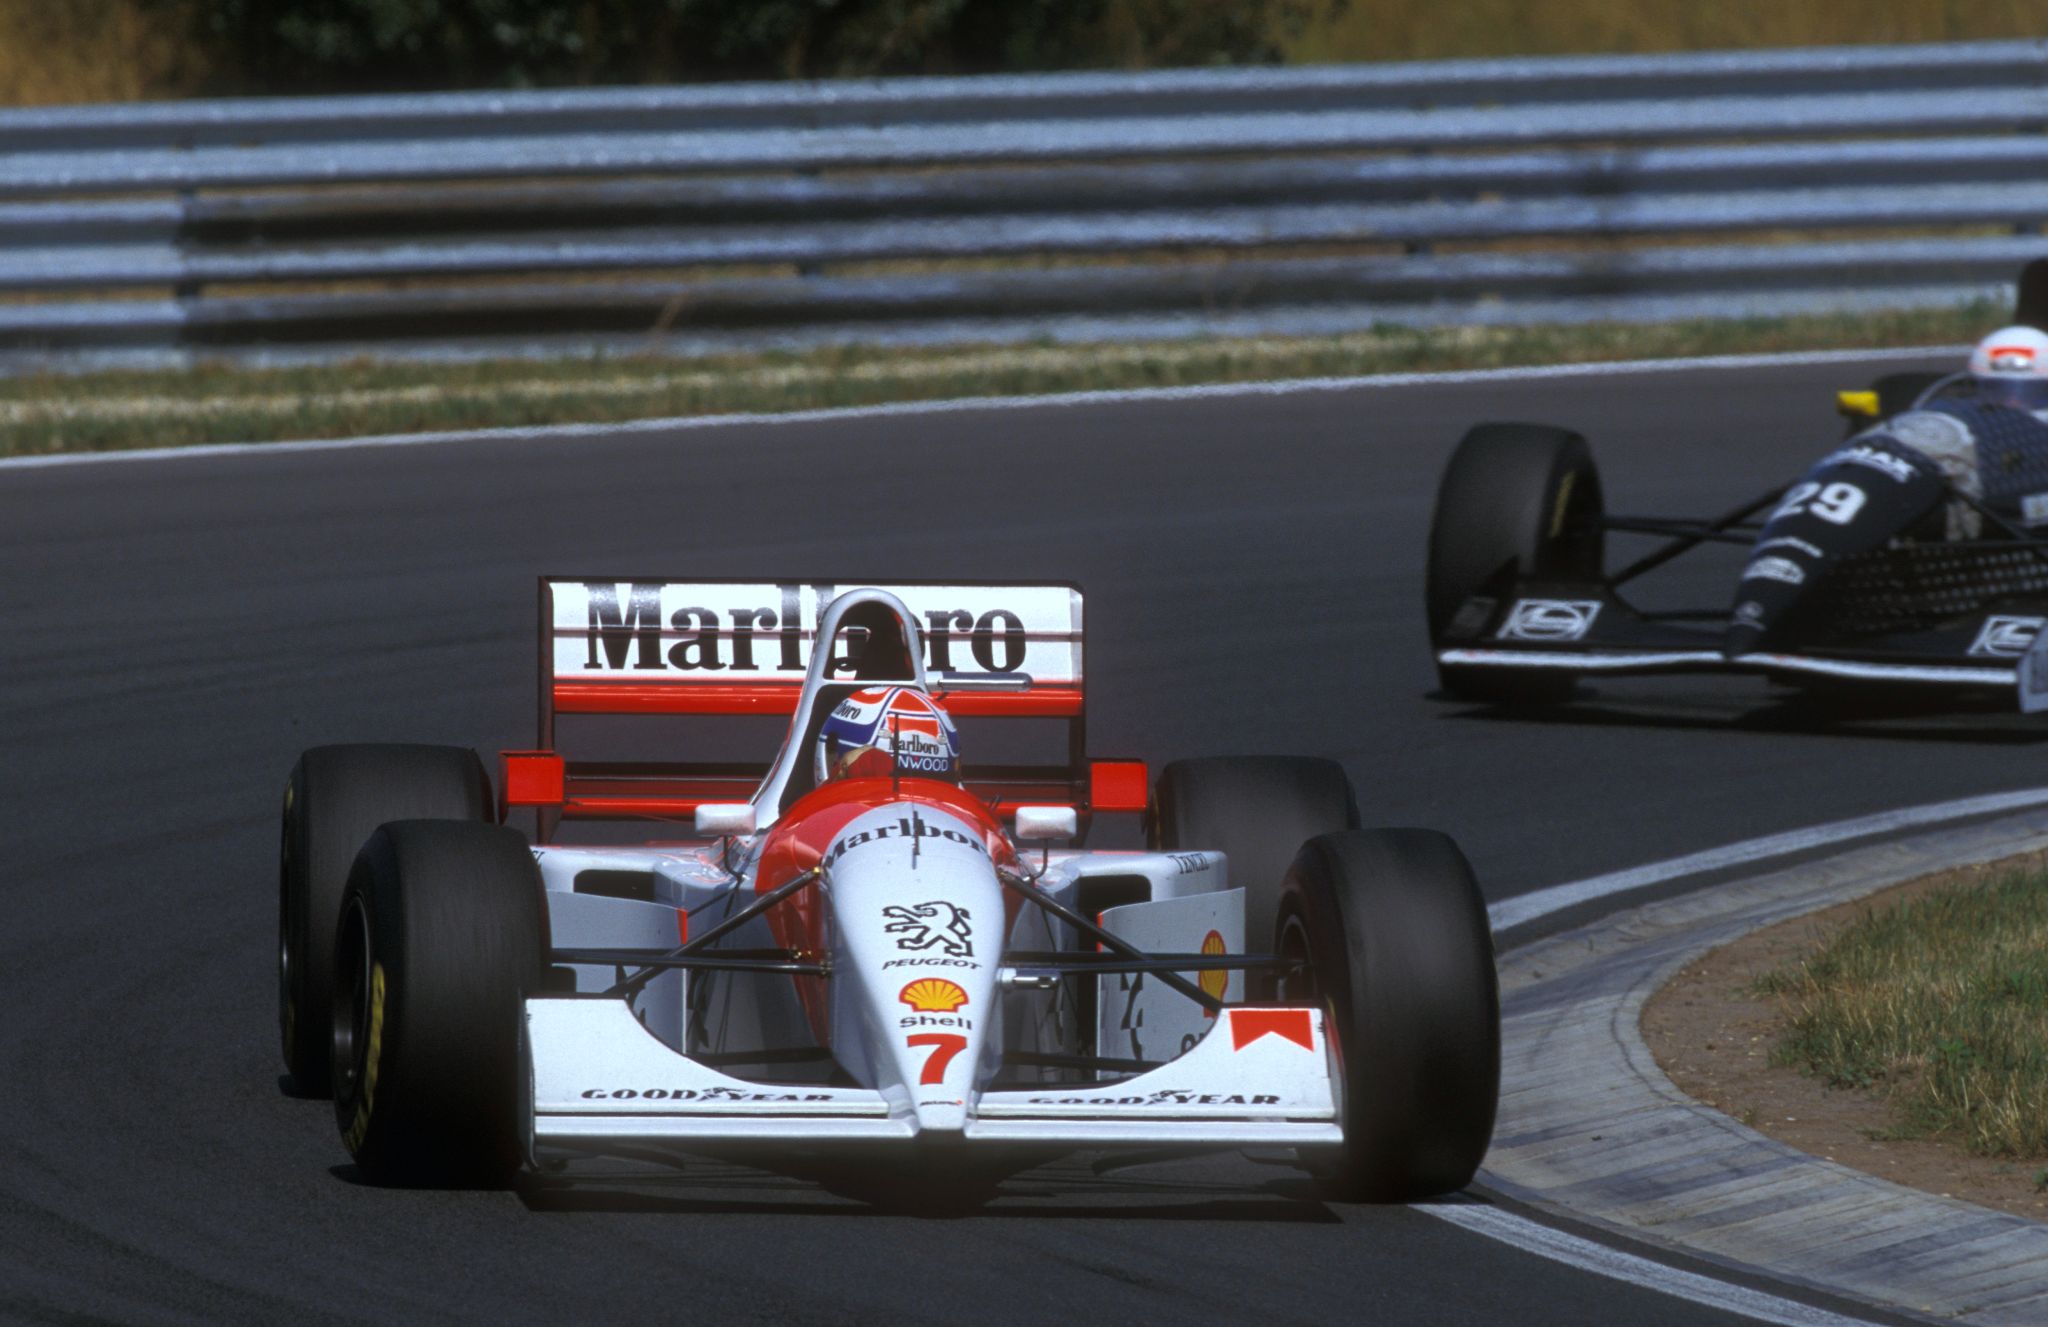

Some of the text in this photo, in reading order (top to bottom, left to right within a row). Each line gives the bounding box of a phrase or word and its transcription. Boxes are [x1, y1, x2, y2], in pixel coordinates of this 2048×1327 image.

[1771, 482, 1867, 524] 29
[583, 583, 1027, 673] Marlro
[898, 756, 949, 771] NWOOD
[881, 958, 983, 971] PEUGEOT
[900, 1015, 973, 1030] Shell
[906, 1033, 968, 1086] 7
